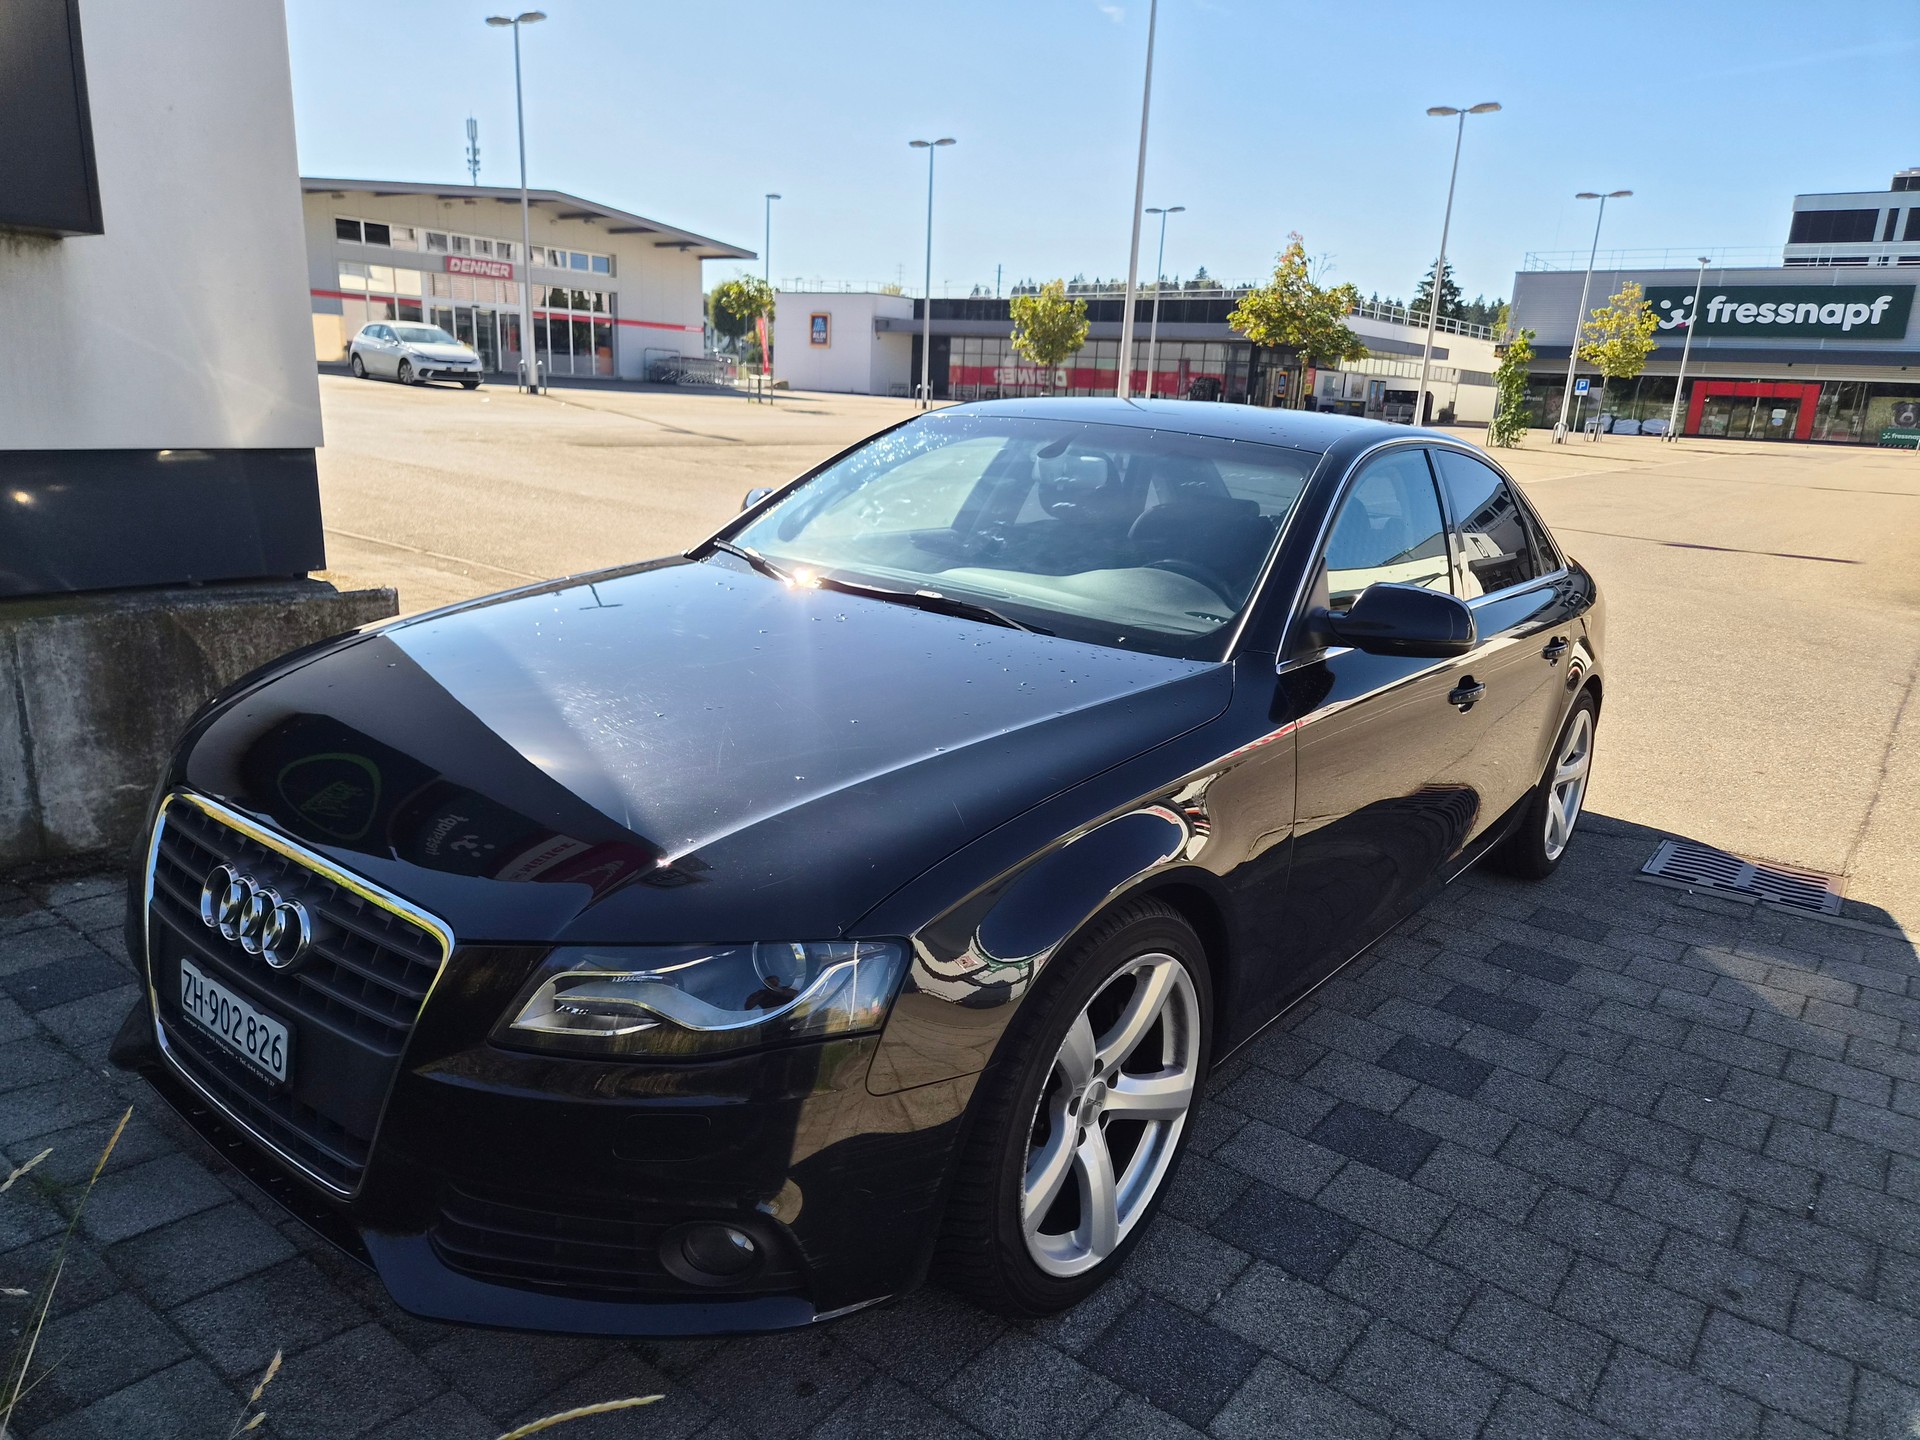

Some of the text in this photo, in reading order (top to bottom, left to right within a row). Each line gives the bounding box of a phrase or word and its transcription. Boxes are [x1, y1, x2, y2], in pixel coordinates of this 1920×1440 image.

[449, 258, 510, 277] DENNER
[1706, 295, 1893, 331] fressnapf
[1579, 381, 1586, 390] P
[1892, 432, 1920, 442] fressnap
